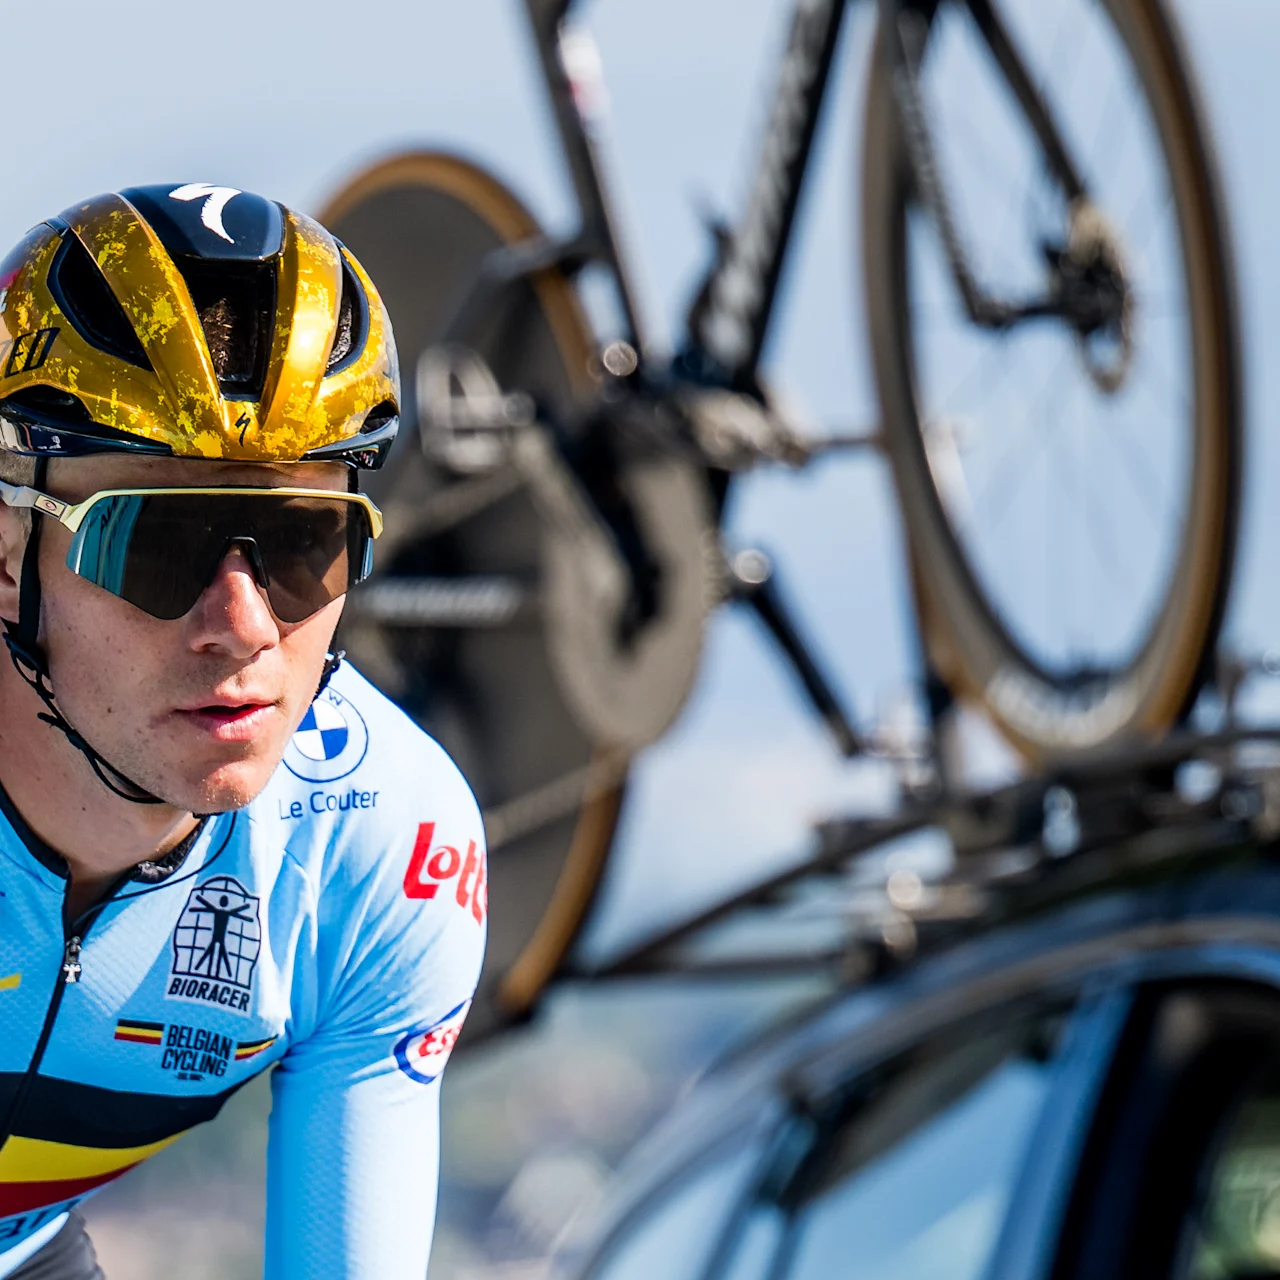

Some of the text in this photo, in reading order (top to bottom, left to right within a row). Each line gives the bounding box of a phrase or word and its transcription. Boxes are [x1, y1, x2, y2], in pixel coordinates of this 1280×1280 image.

[278, 789, 380, 820] Le Couter
[403, 822, 488, 928] Lott
[168, 977, 251, 1012] BIORACER
[166, 1023, 233, 1061] BELGIAN
[161, 1047, 229, 1078] CYCLING
